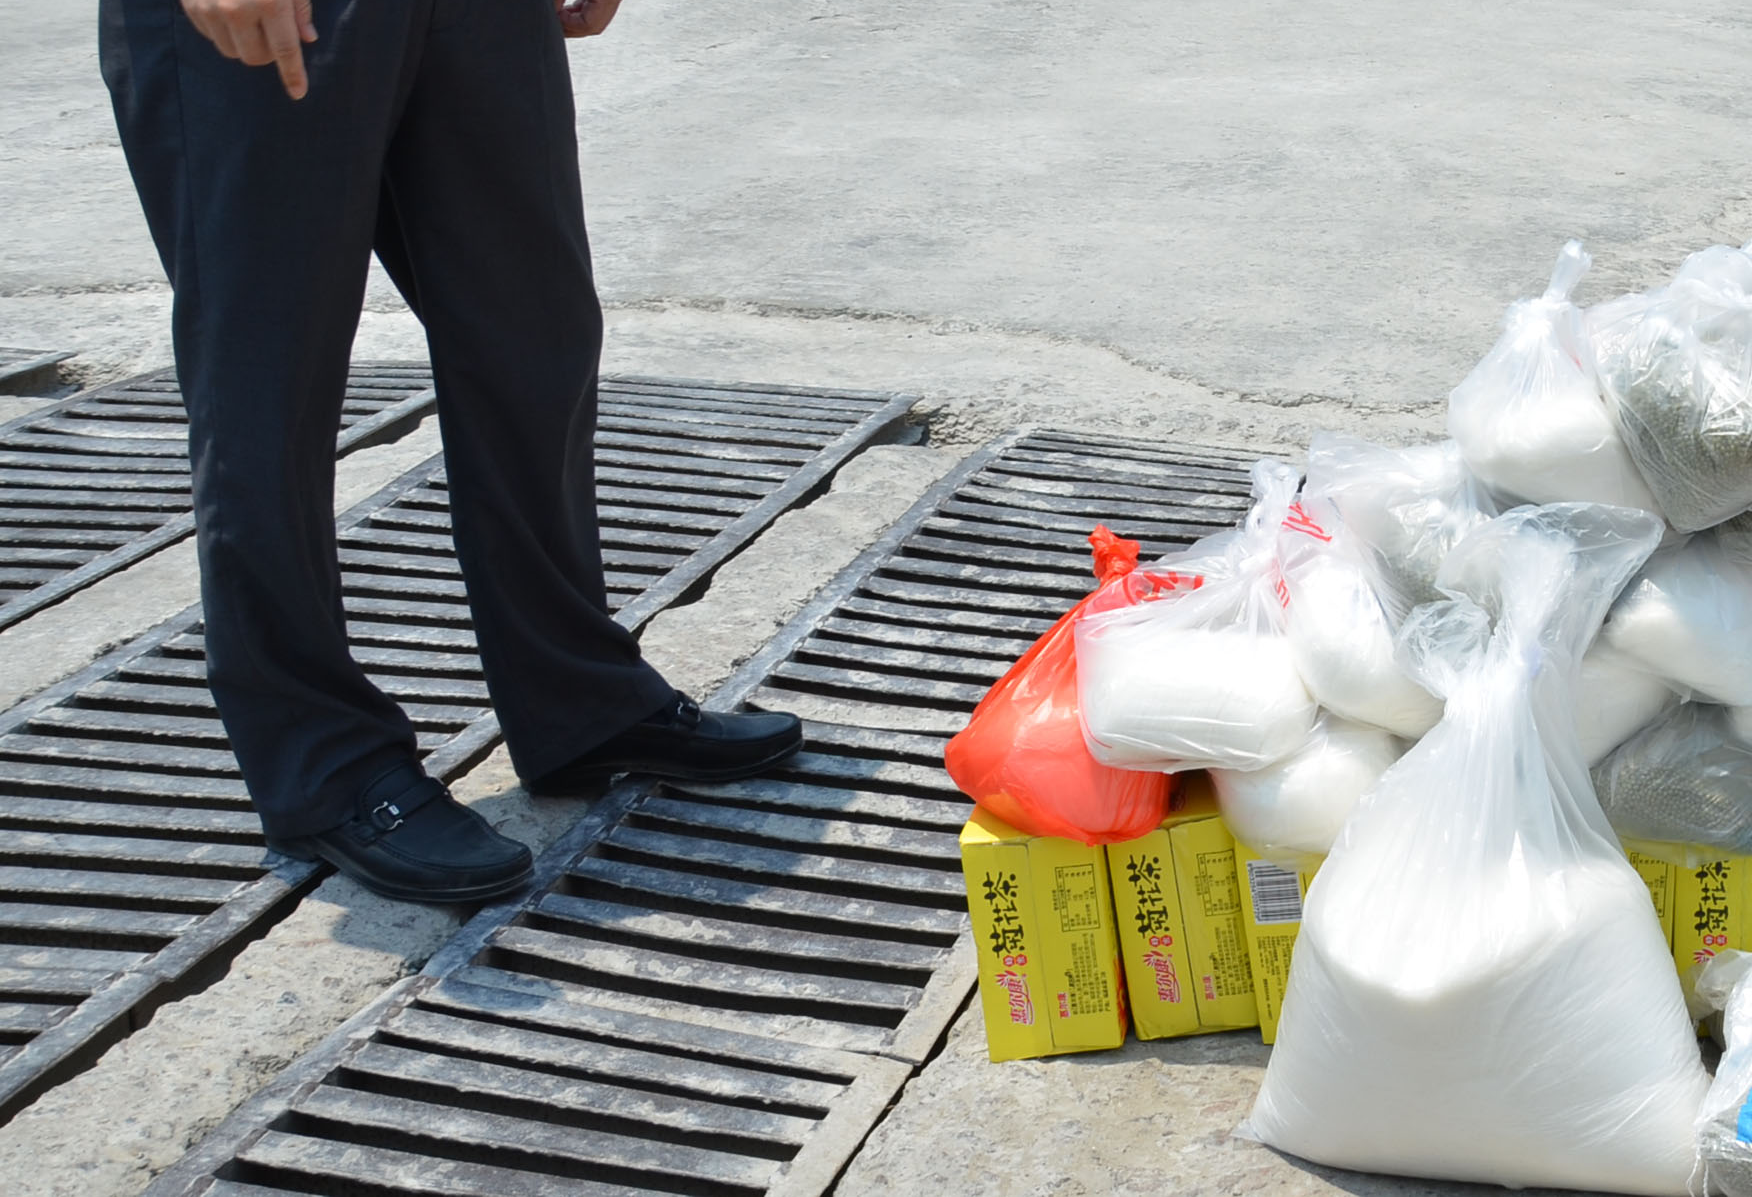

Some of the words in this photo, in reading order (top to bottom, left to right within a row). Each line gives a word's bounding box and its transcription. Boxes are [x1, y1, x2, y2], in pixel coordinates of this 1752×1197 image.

[983, 870, 1026, 957] 菊花茶
[1126, 853, 1171, 940] 菊花茶
[1693, 860, 1731, 937] 菊花茶
